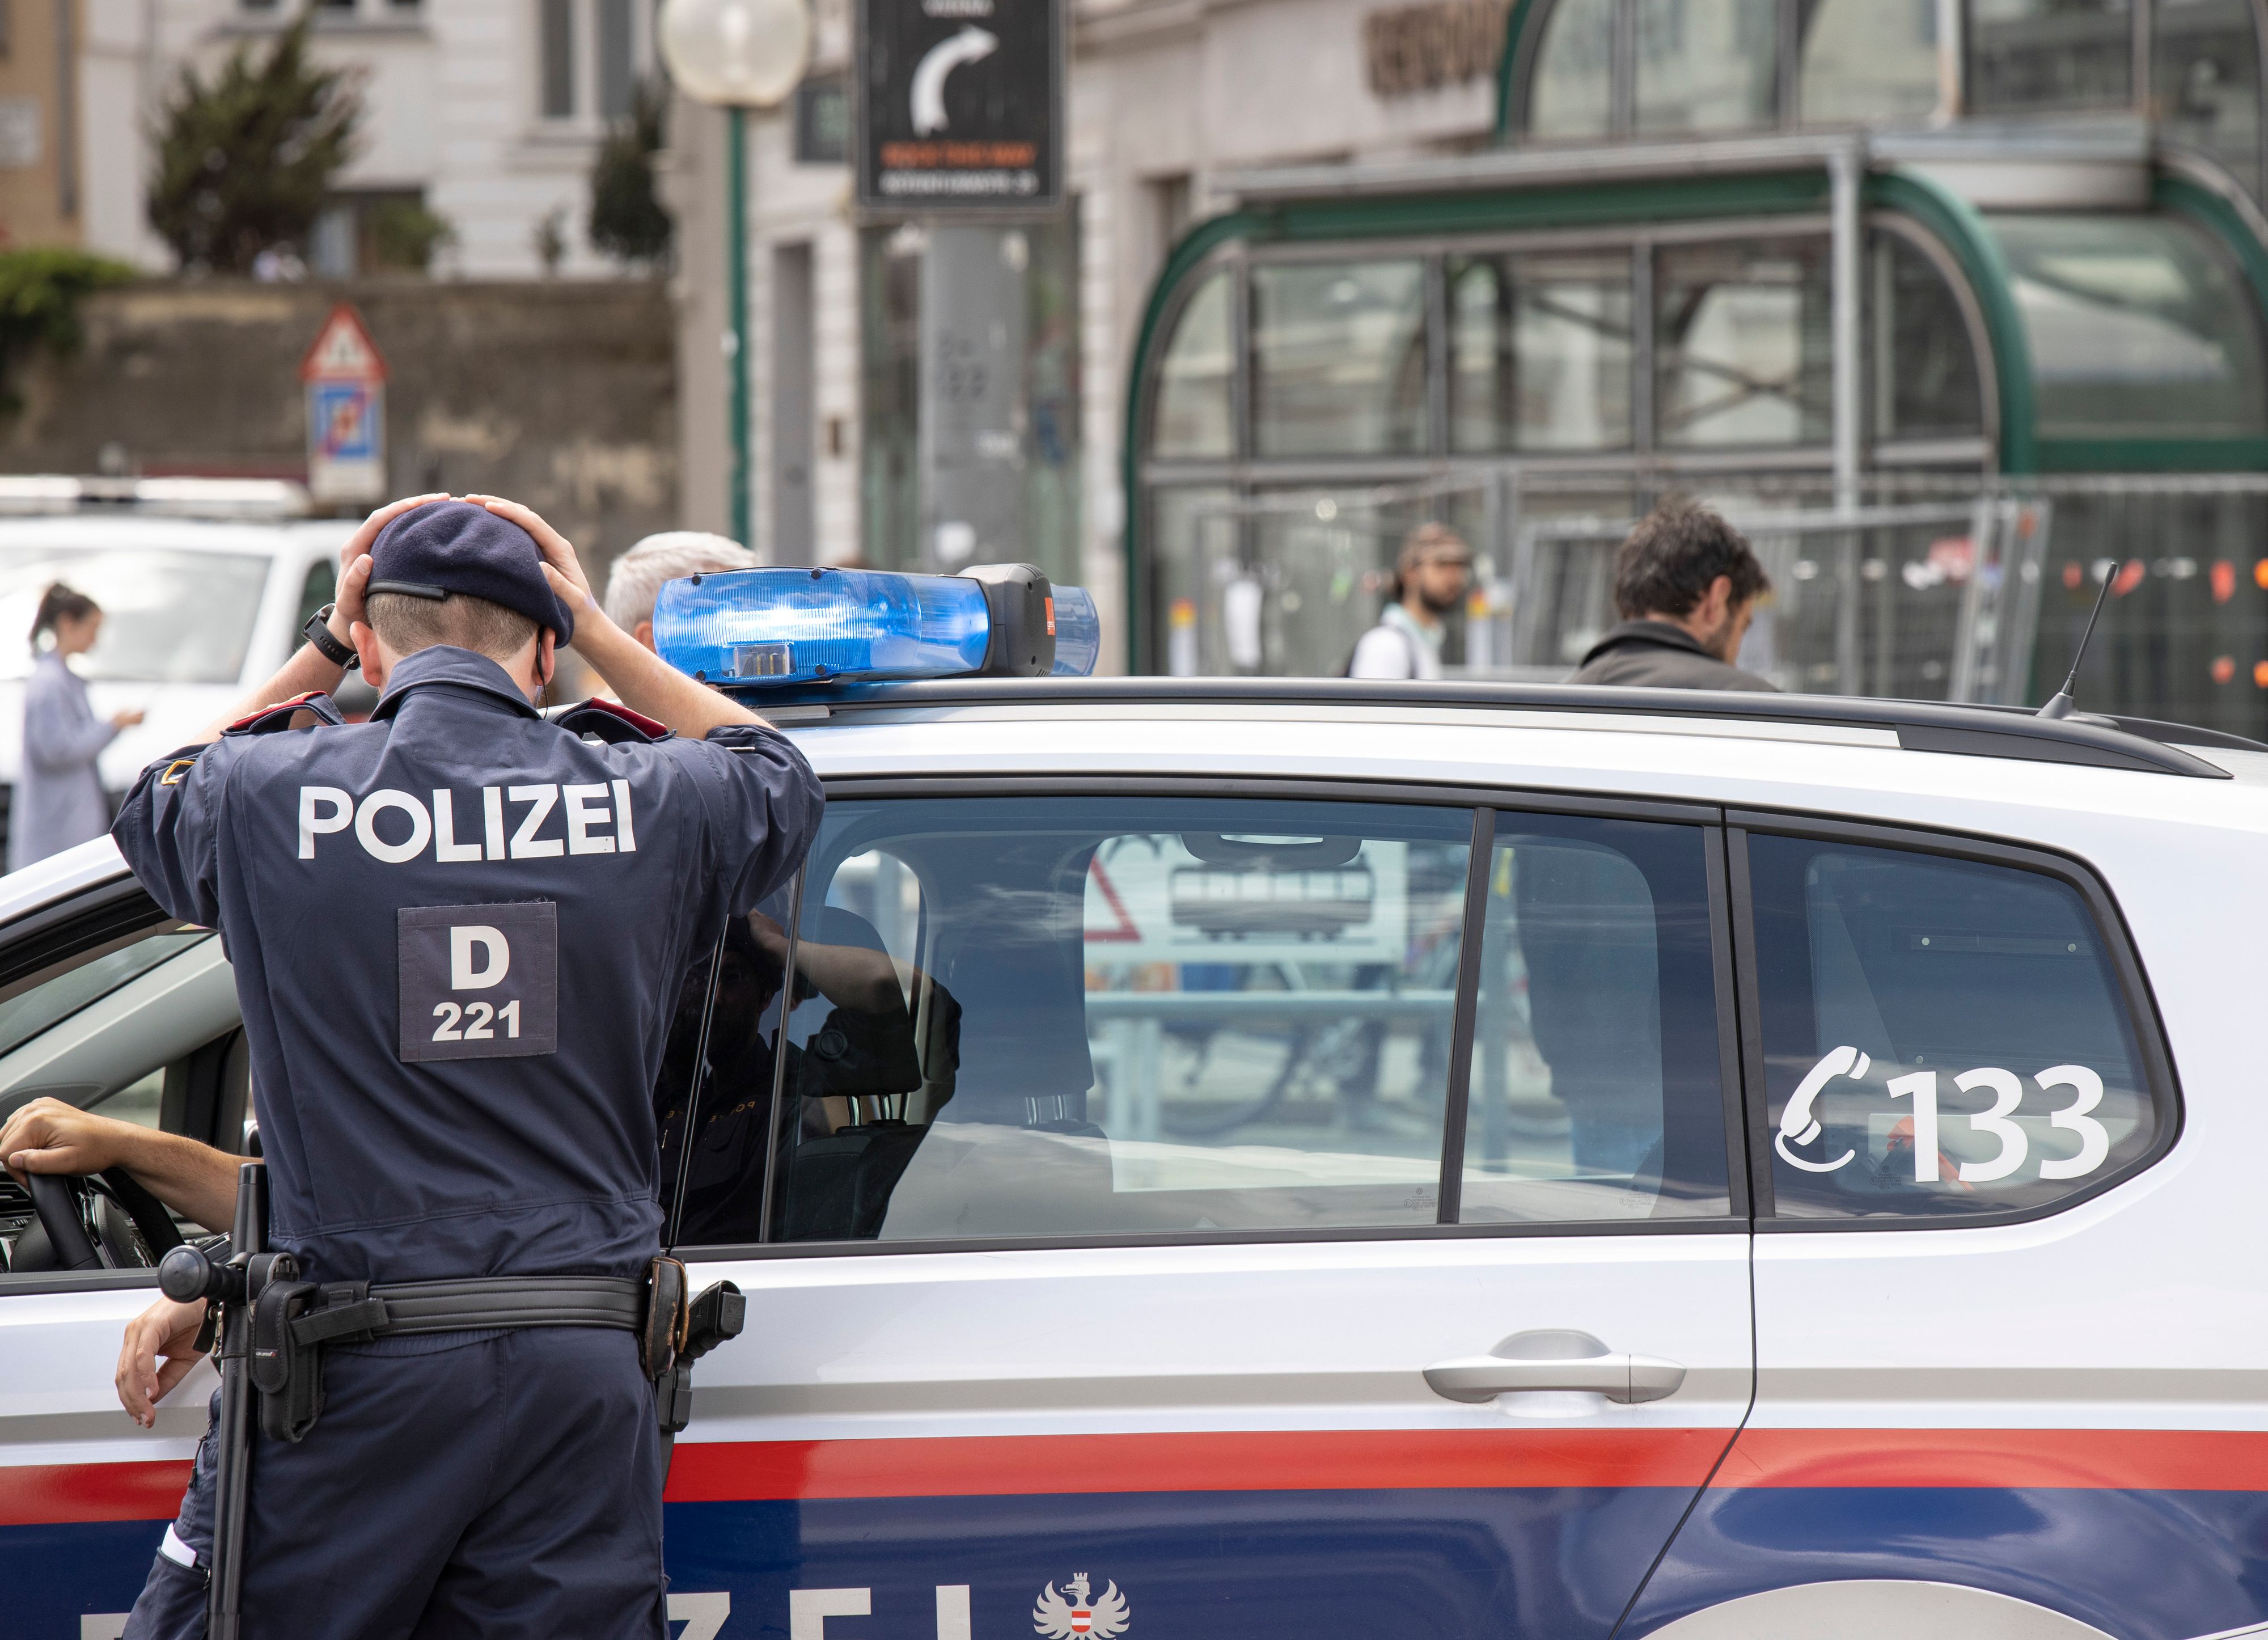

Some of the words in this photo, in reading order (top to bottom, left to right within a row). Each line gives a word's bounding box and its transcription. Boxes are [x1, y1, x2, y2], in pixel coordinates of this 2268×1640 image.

[299, 779, 636, 863] POLIZEI
[451, 926, 509, 990] D
[433, 1000, 519, 1041] 221
[1887, 1066, 2109, 1181] 133
